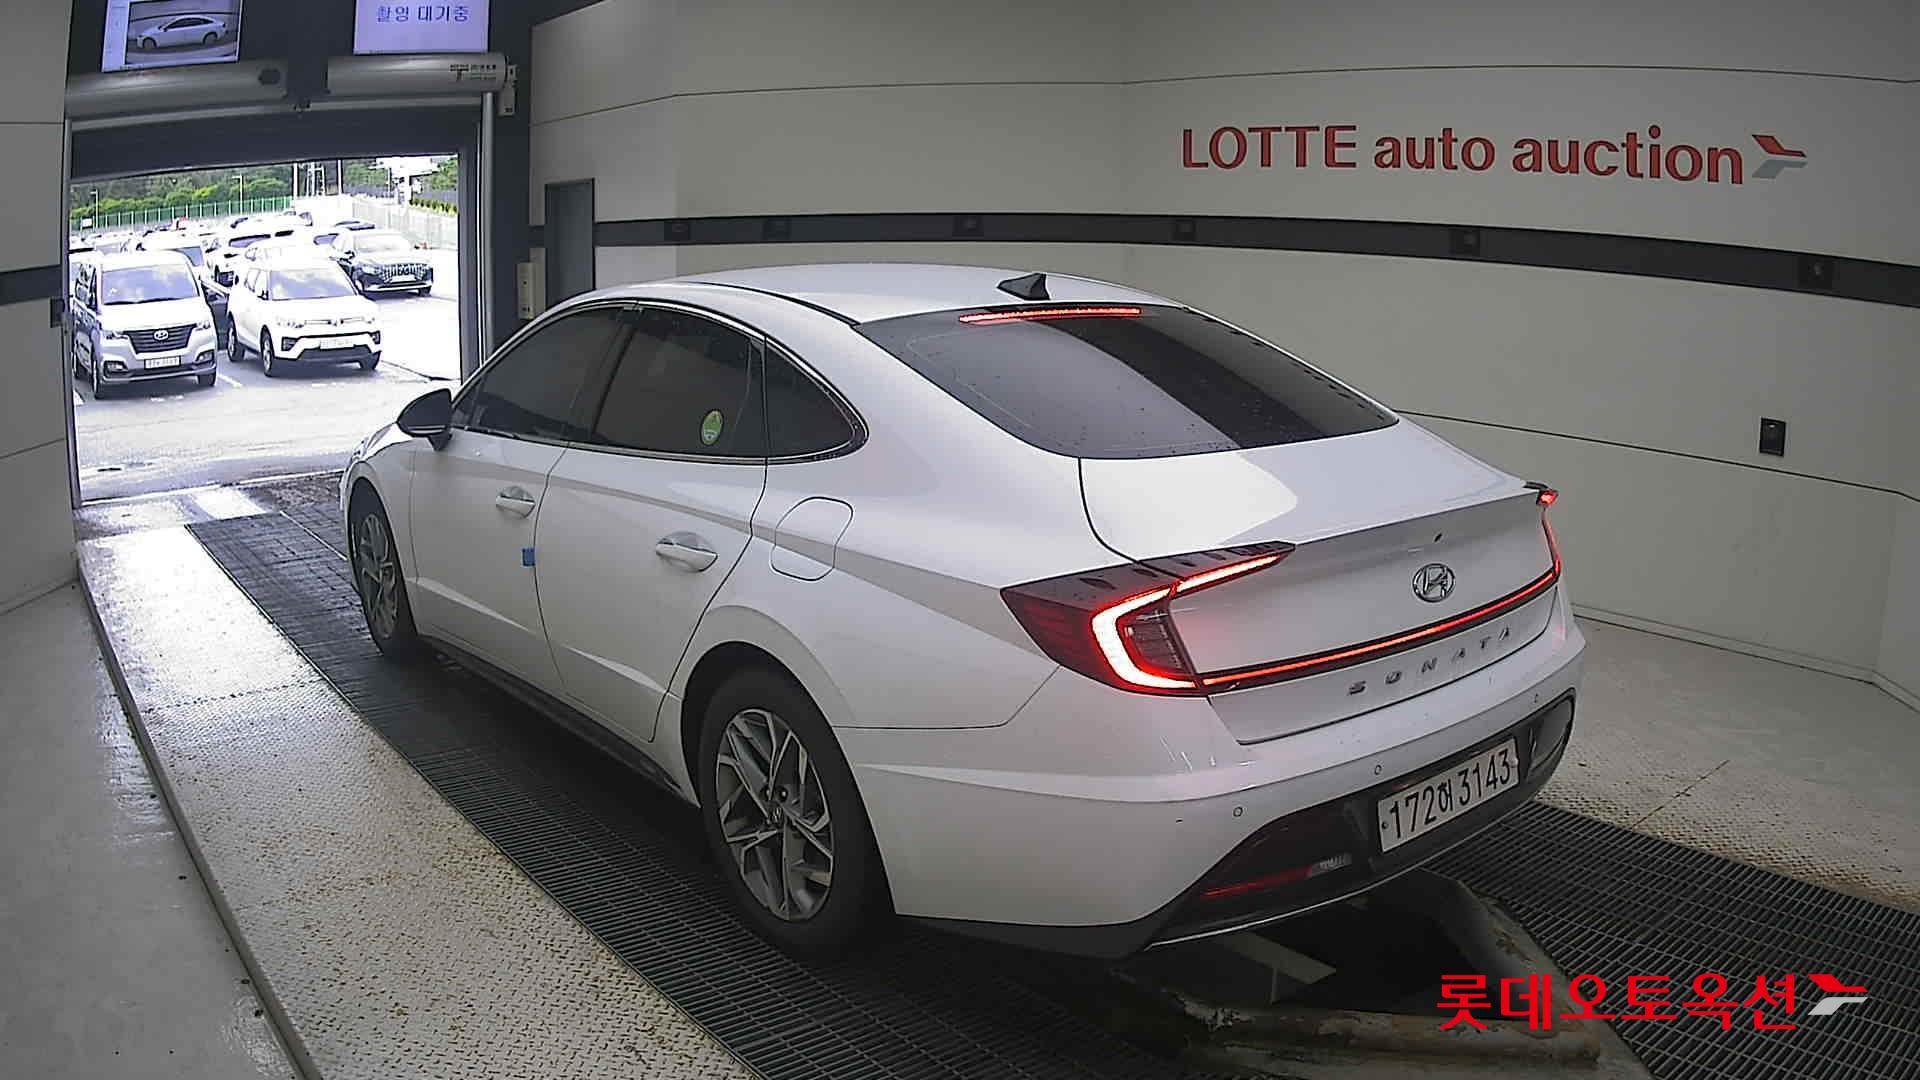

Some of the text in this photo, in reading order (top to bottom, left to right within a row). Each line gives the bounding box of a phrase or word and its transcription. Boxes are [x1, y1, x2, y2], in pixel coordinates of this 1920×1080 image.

[418, 6, 470, 22] 대기중
[1182, 124, 1744, 185] LOTTE auto auction
[1349, 626, 1510, 696] SONATA
